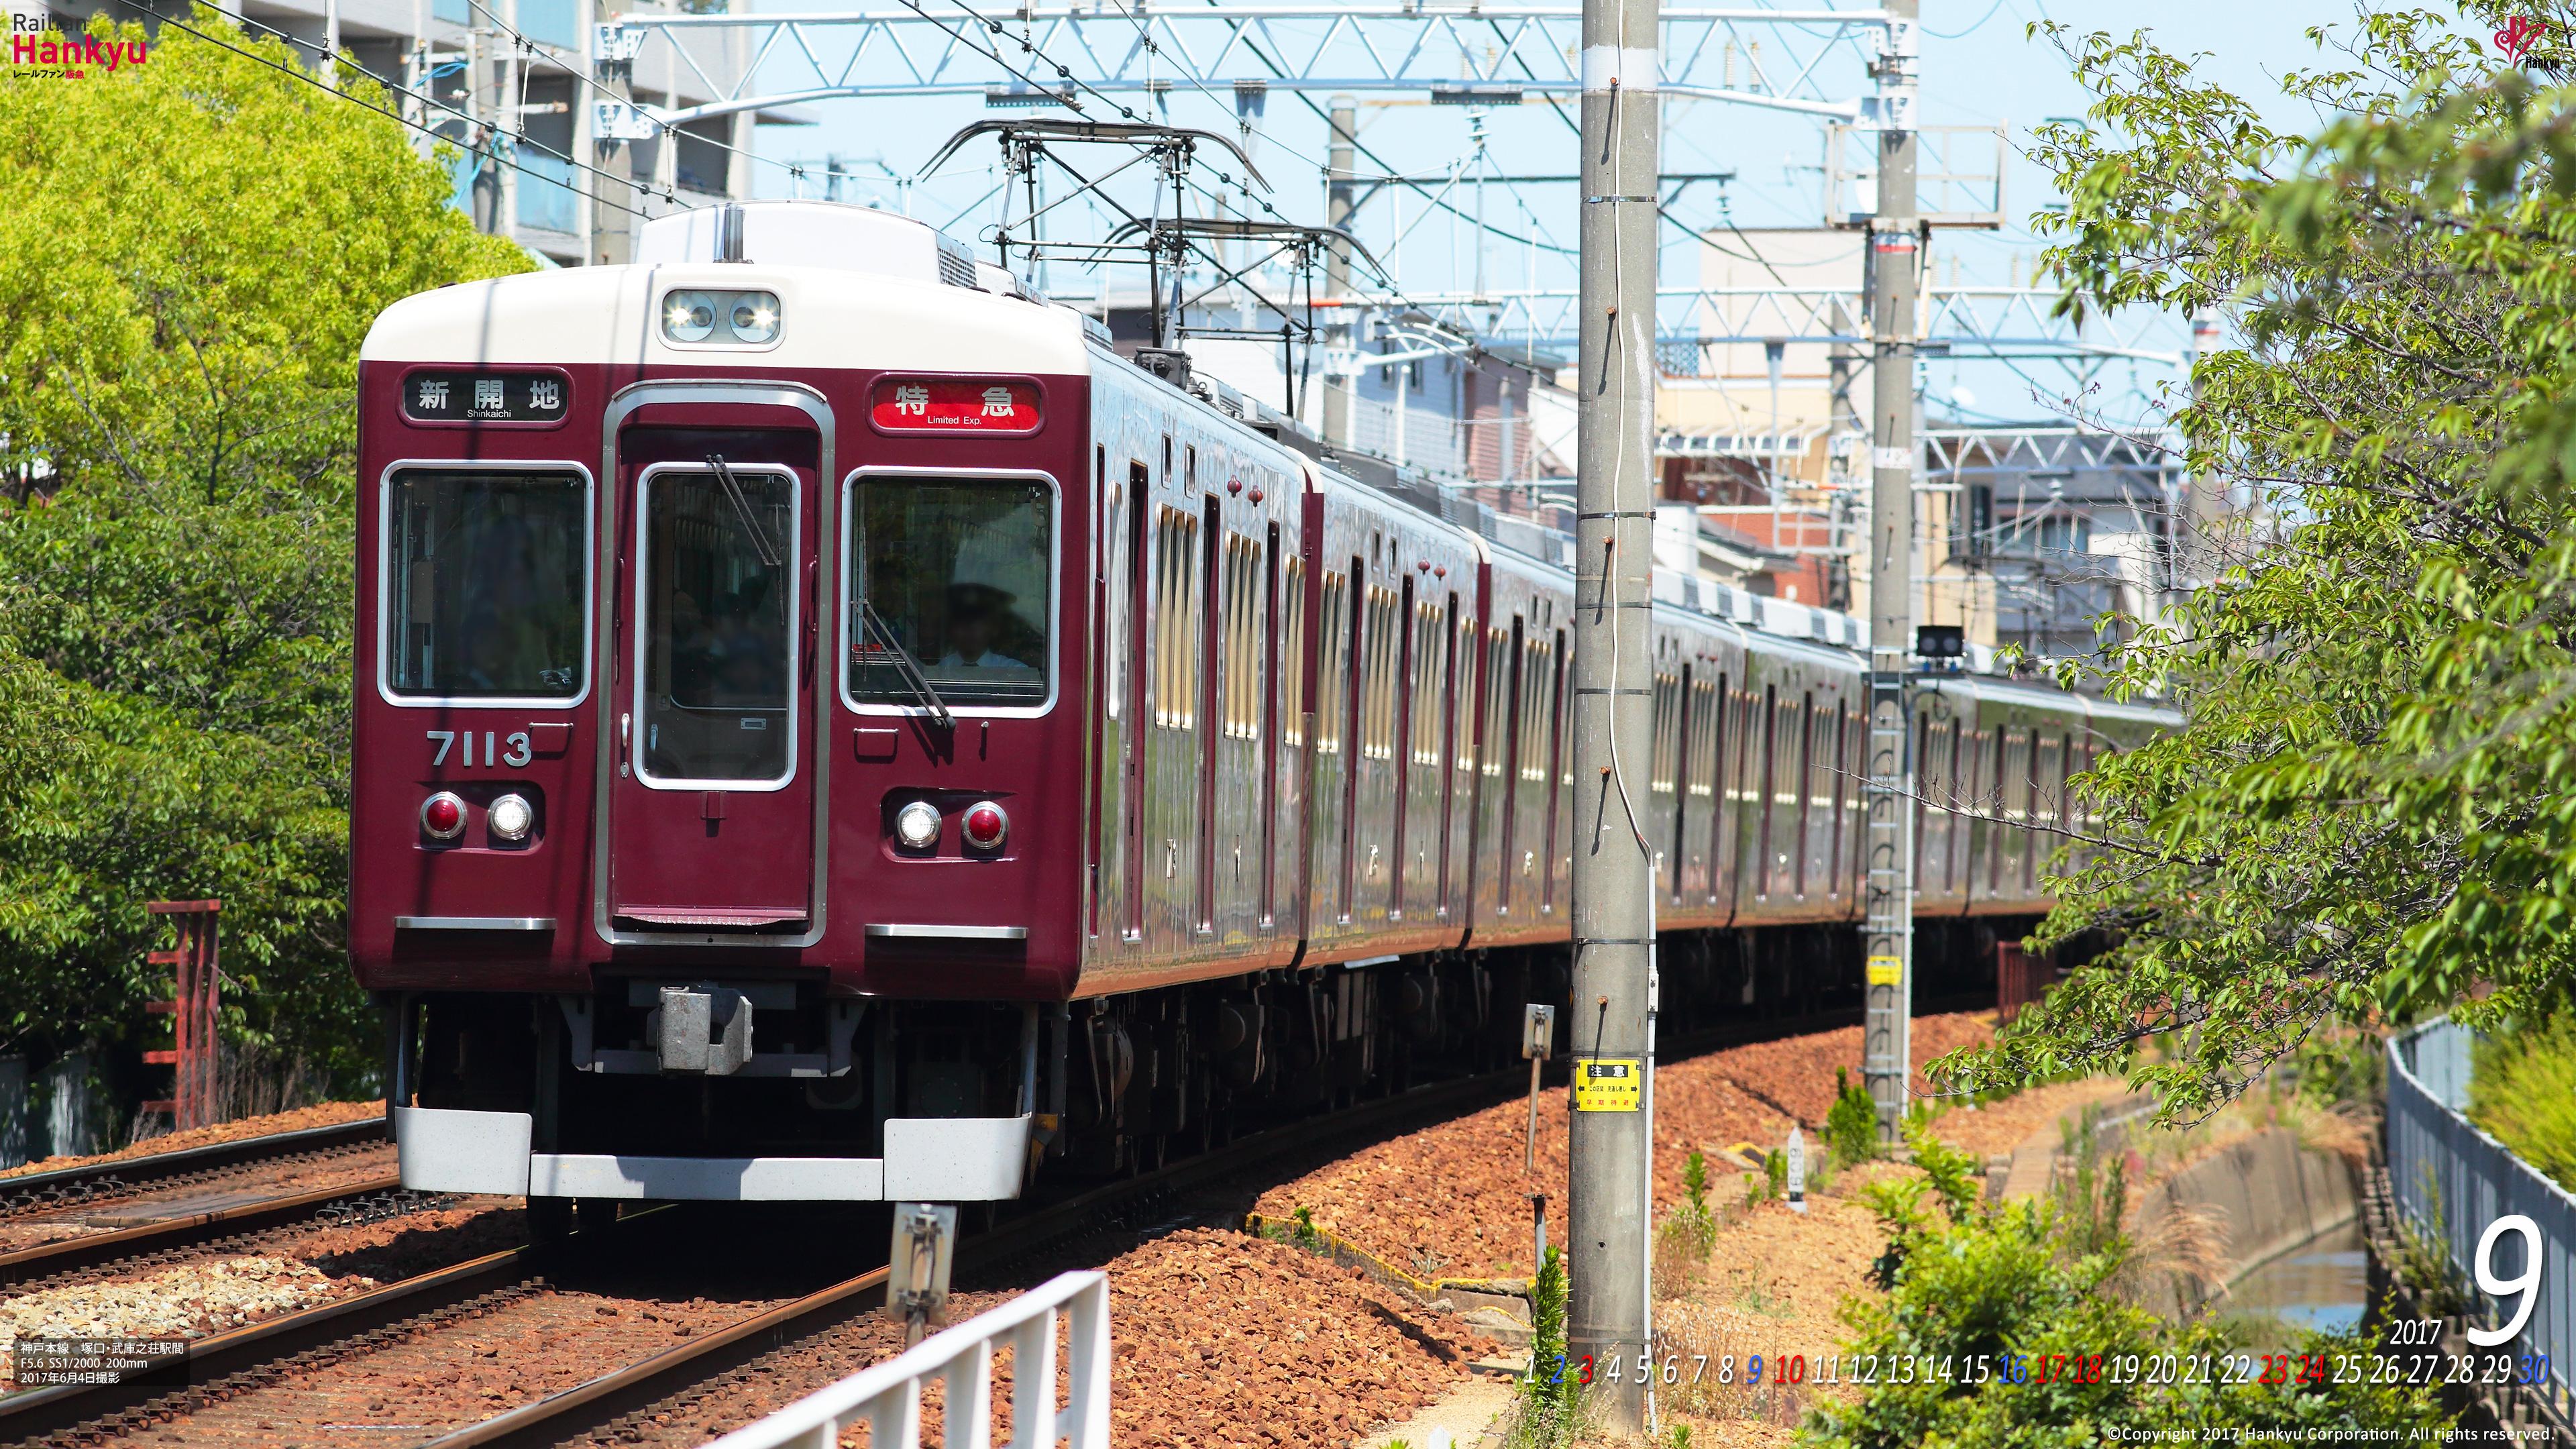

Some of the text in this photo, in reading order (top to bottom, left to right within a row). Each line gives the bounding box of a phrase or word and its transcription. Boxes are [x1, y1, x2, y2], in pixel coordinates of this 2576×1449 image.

[419, 379, 559, 409] 新開地
[896, 385, 1014, 417] 特急
[467, 409, 511, 418] Shinkaichi
[928, 415, 981, 425] Limited Exp.
[427, 731, 532, 767] 7113
[1591, 1065, 1625, 1077] 注意
